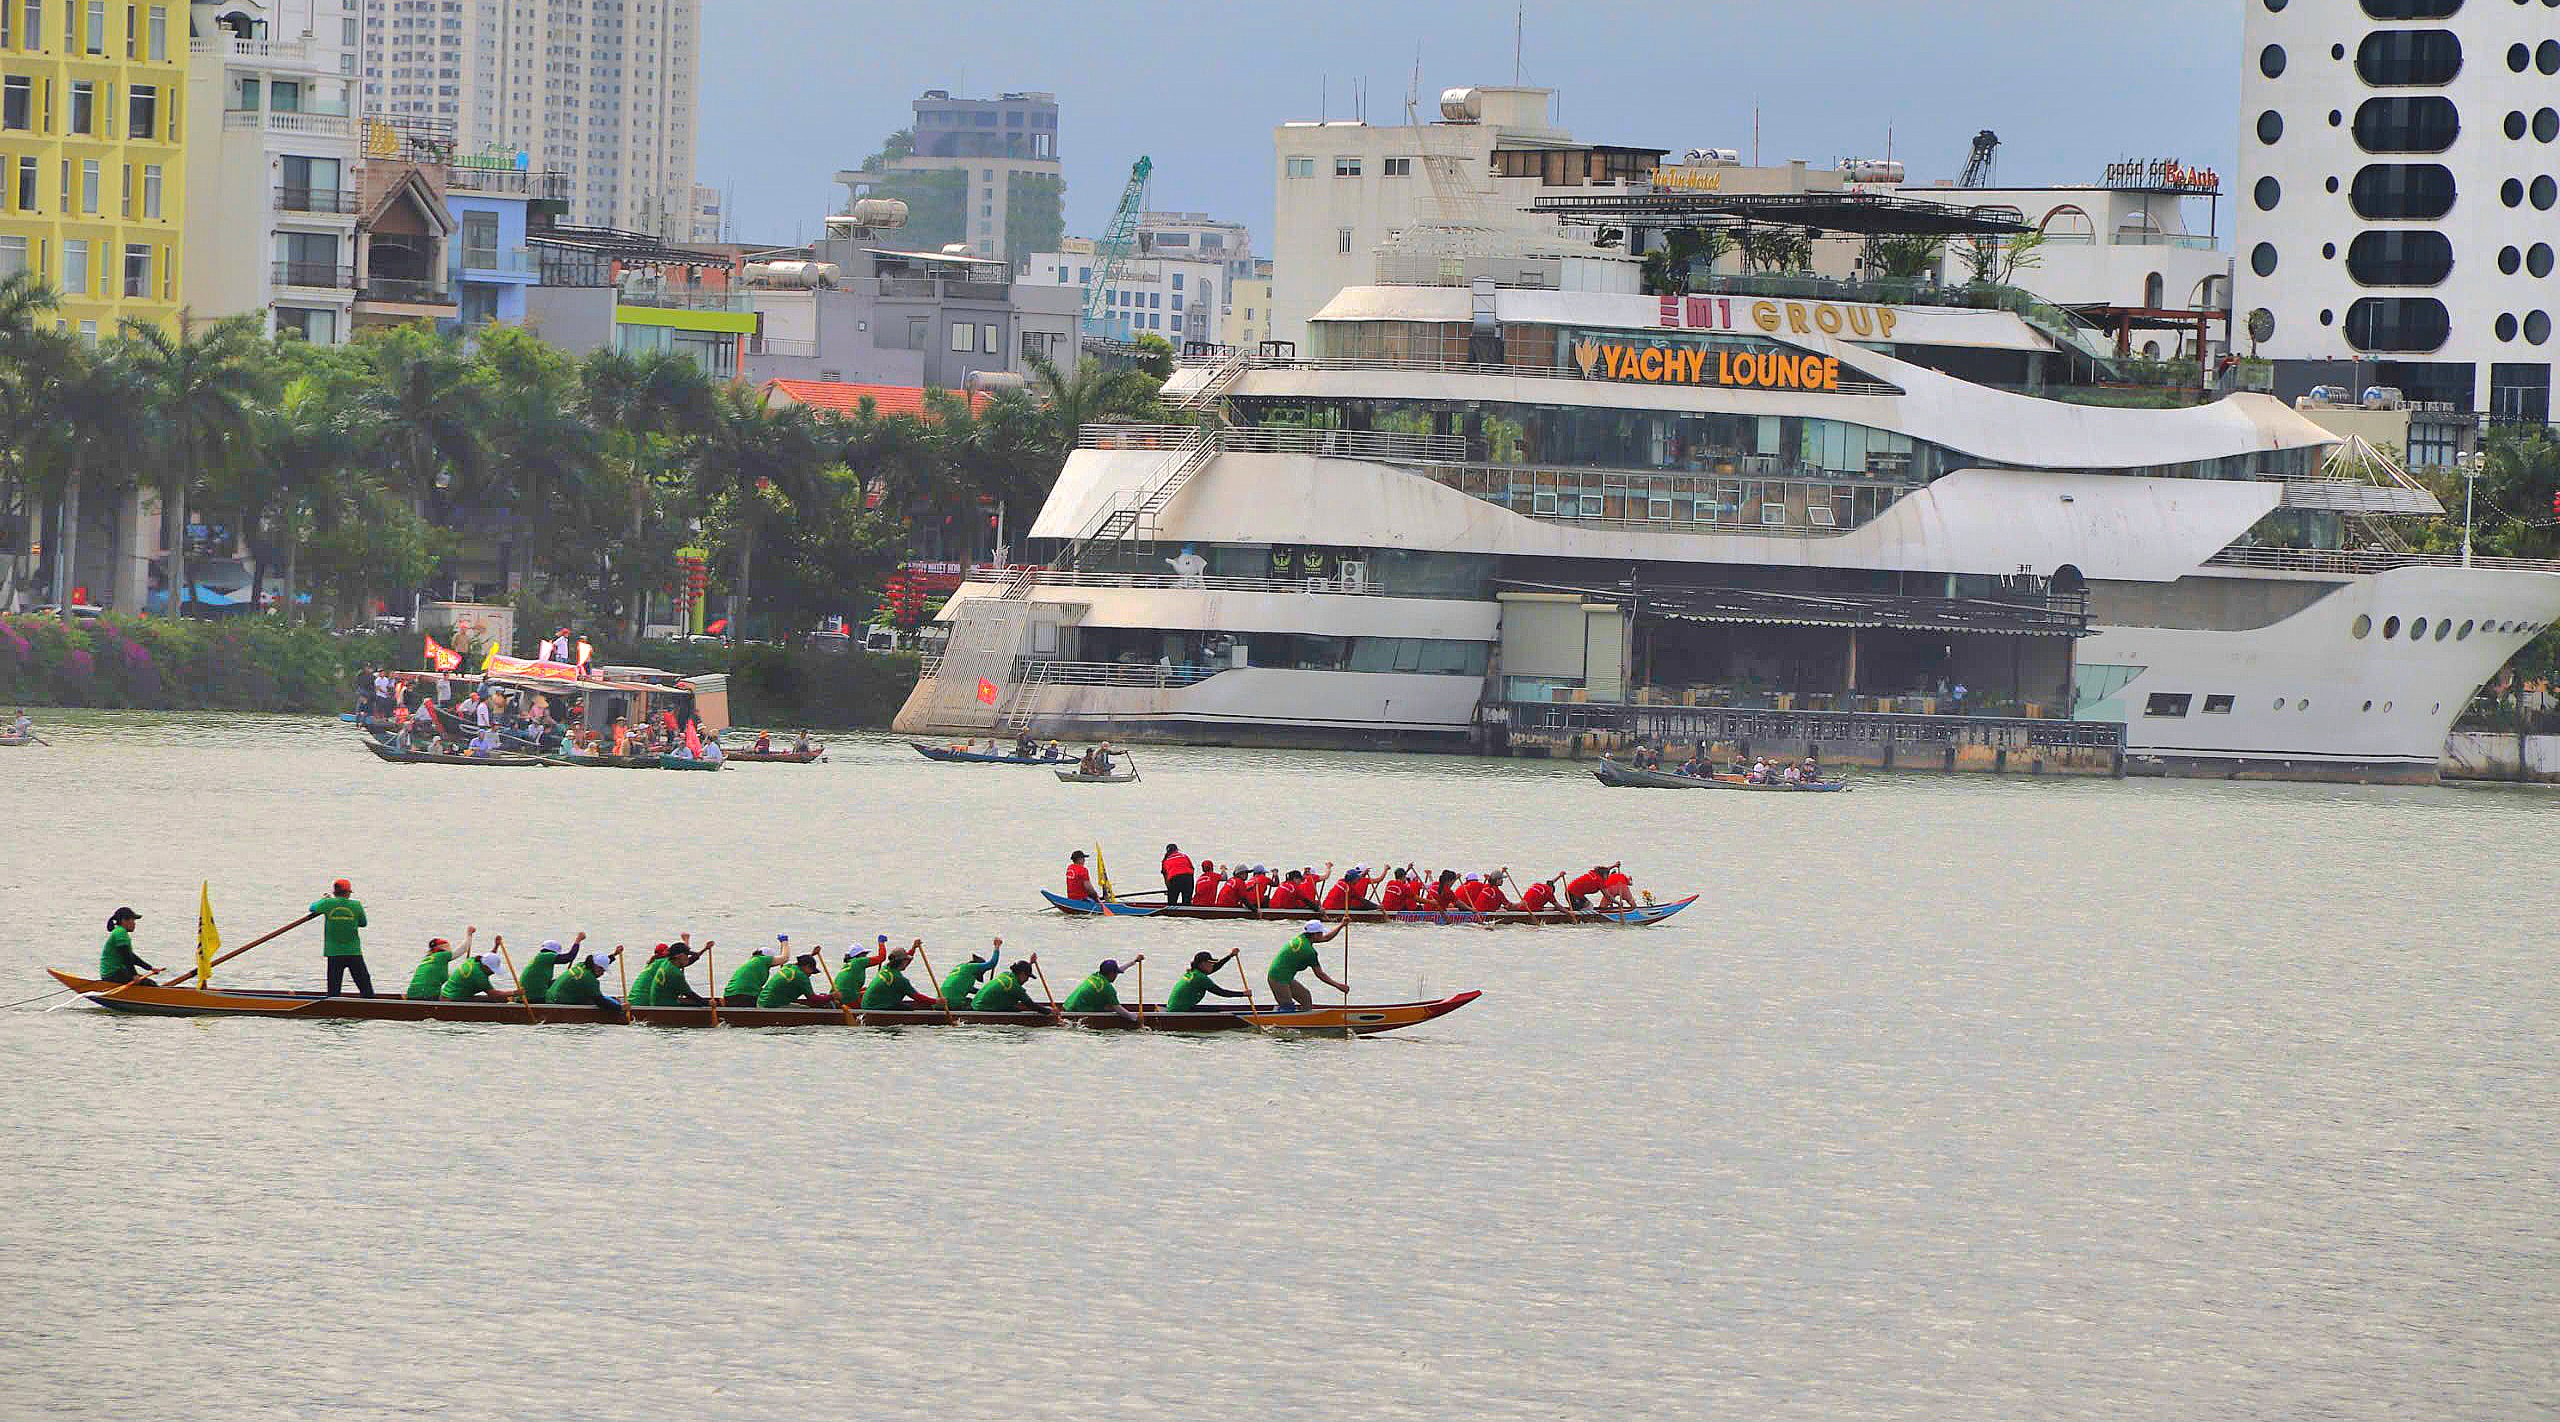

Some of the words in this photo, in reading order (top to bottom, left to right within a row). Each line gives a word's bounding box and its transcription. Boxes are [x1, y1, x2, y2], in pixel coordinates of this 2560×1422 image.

[1752, 300, 1897, 338] GROUP
[1601, 344, 1706, 384] YACHY
[1718, 349, 1840, 390] LOUNGE
